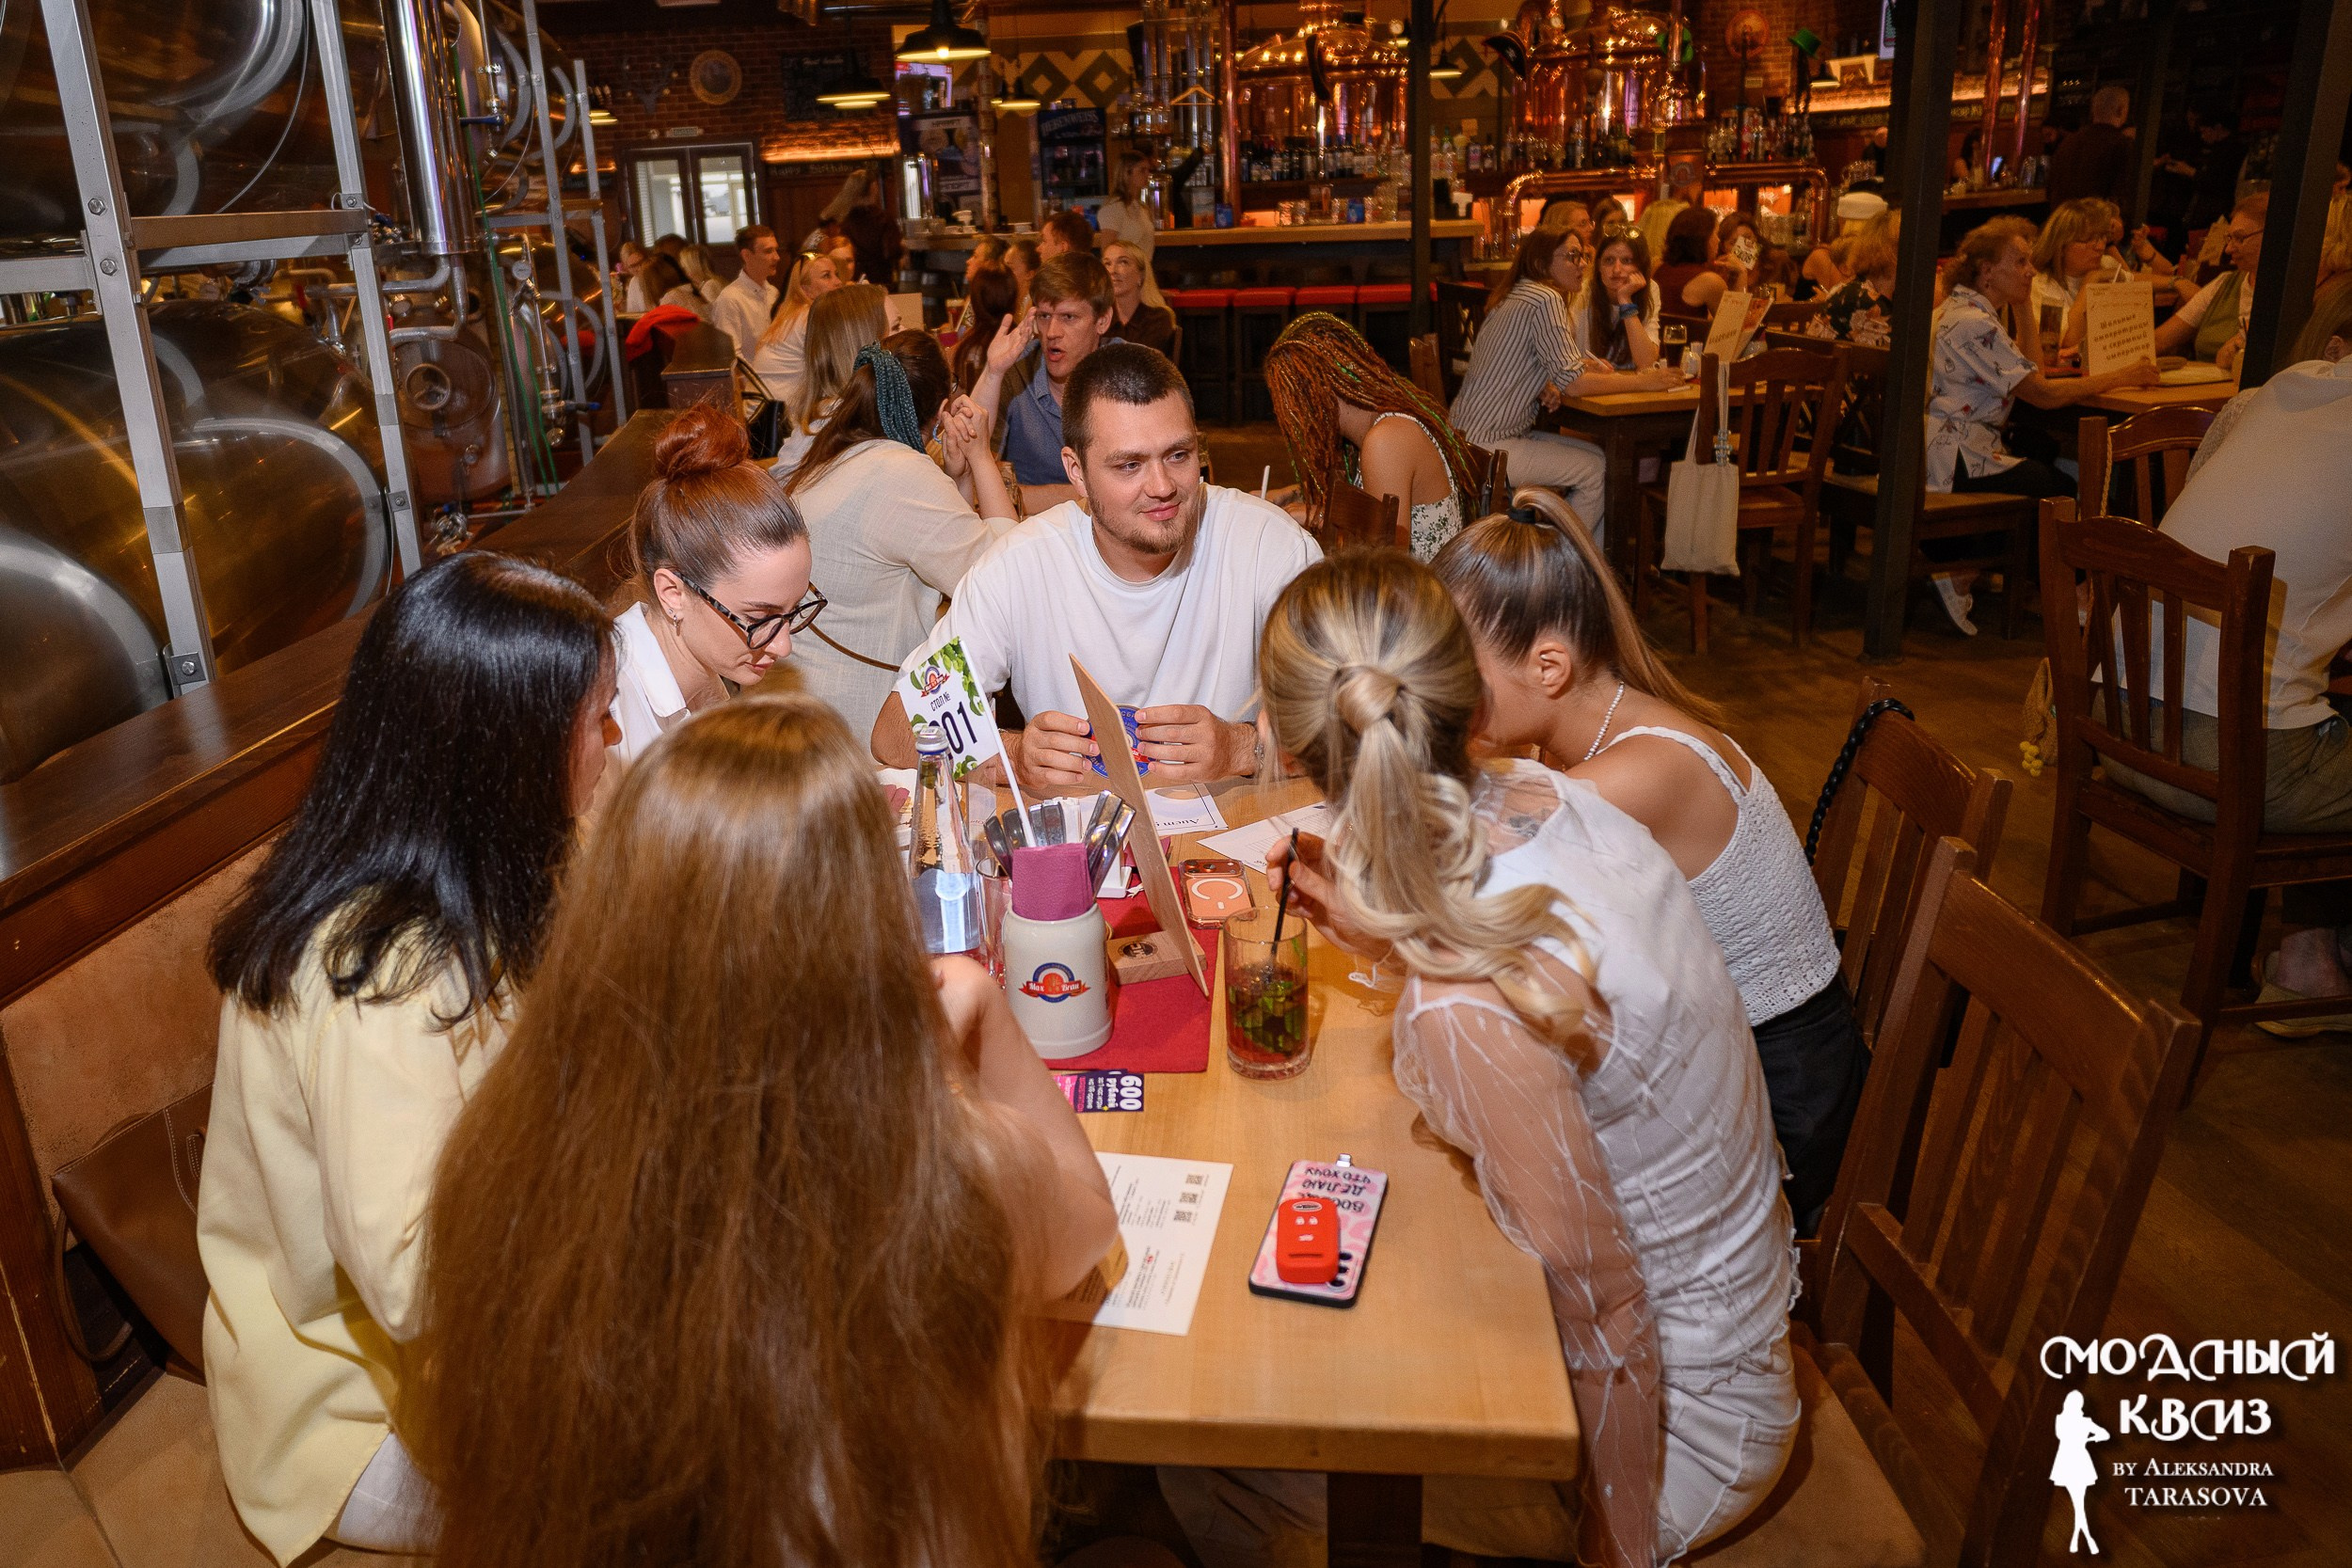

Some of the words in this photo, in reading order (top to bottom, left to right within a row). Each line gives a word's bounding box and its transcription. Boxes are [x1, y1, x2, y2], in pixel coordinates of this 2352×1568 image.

[2100, 314, 2136, 329] Шальные
[930, 696, 945, 711] СТОЛ
[930, 701, 977, 760] 01
[1028, 982, 1044, 992] Max
[1105, 1078, 1120, 1108] рублей
[1120, 1075, 1142, 1111] 600
[1305, 1166, 1341, 1178] ХОЧУ
[1343, 1171, 1371, 1183] ЧТО
[1302, 1179, 1366, 1196] ДЕЛАЮ
